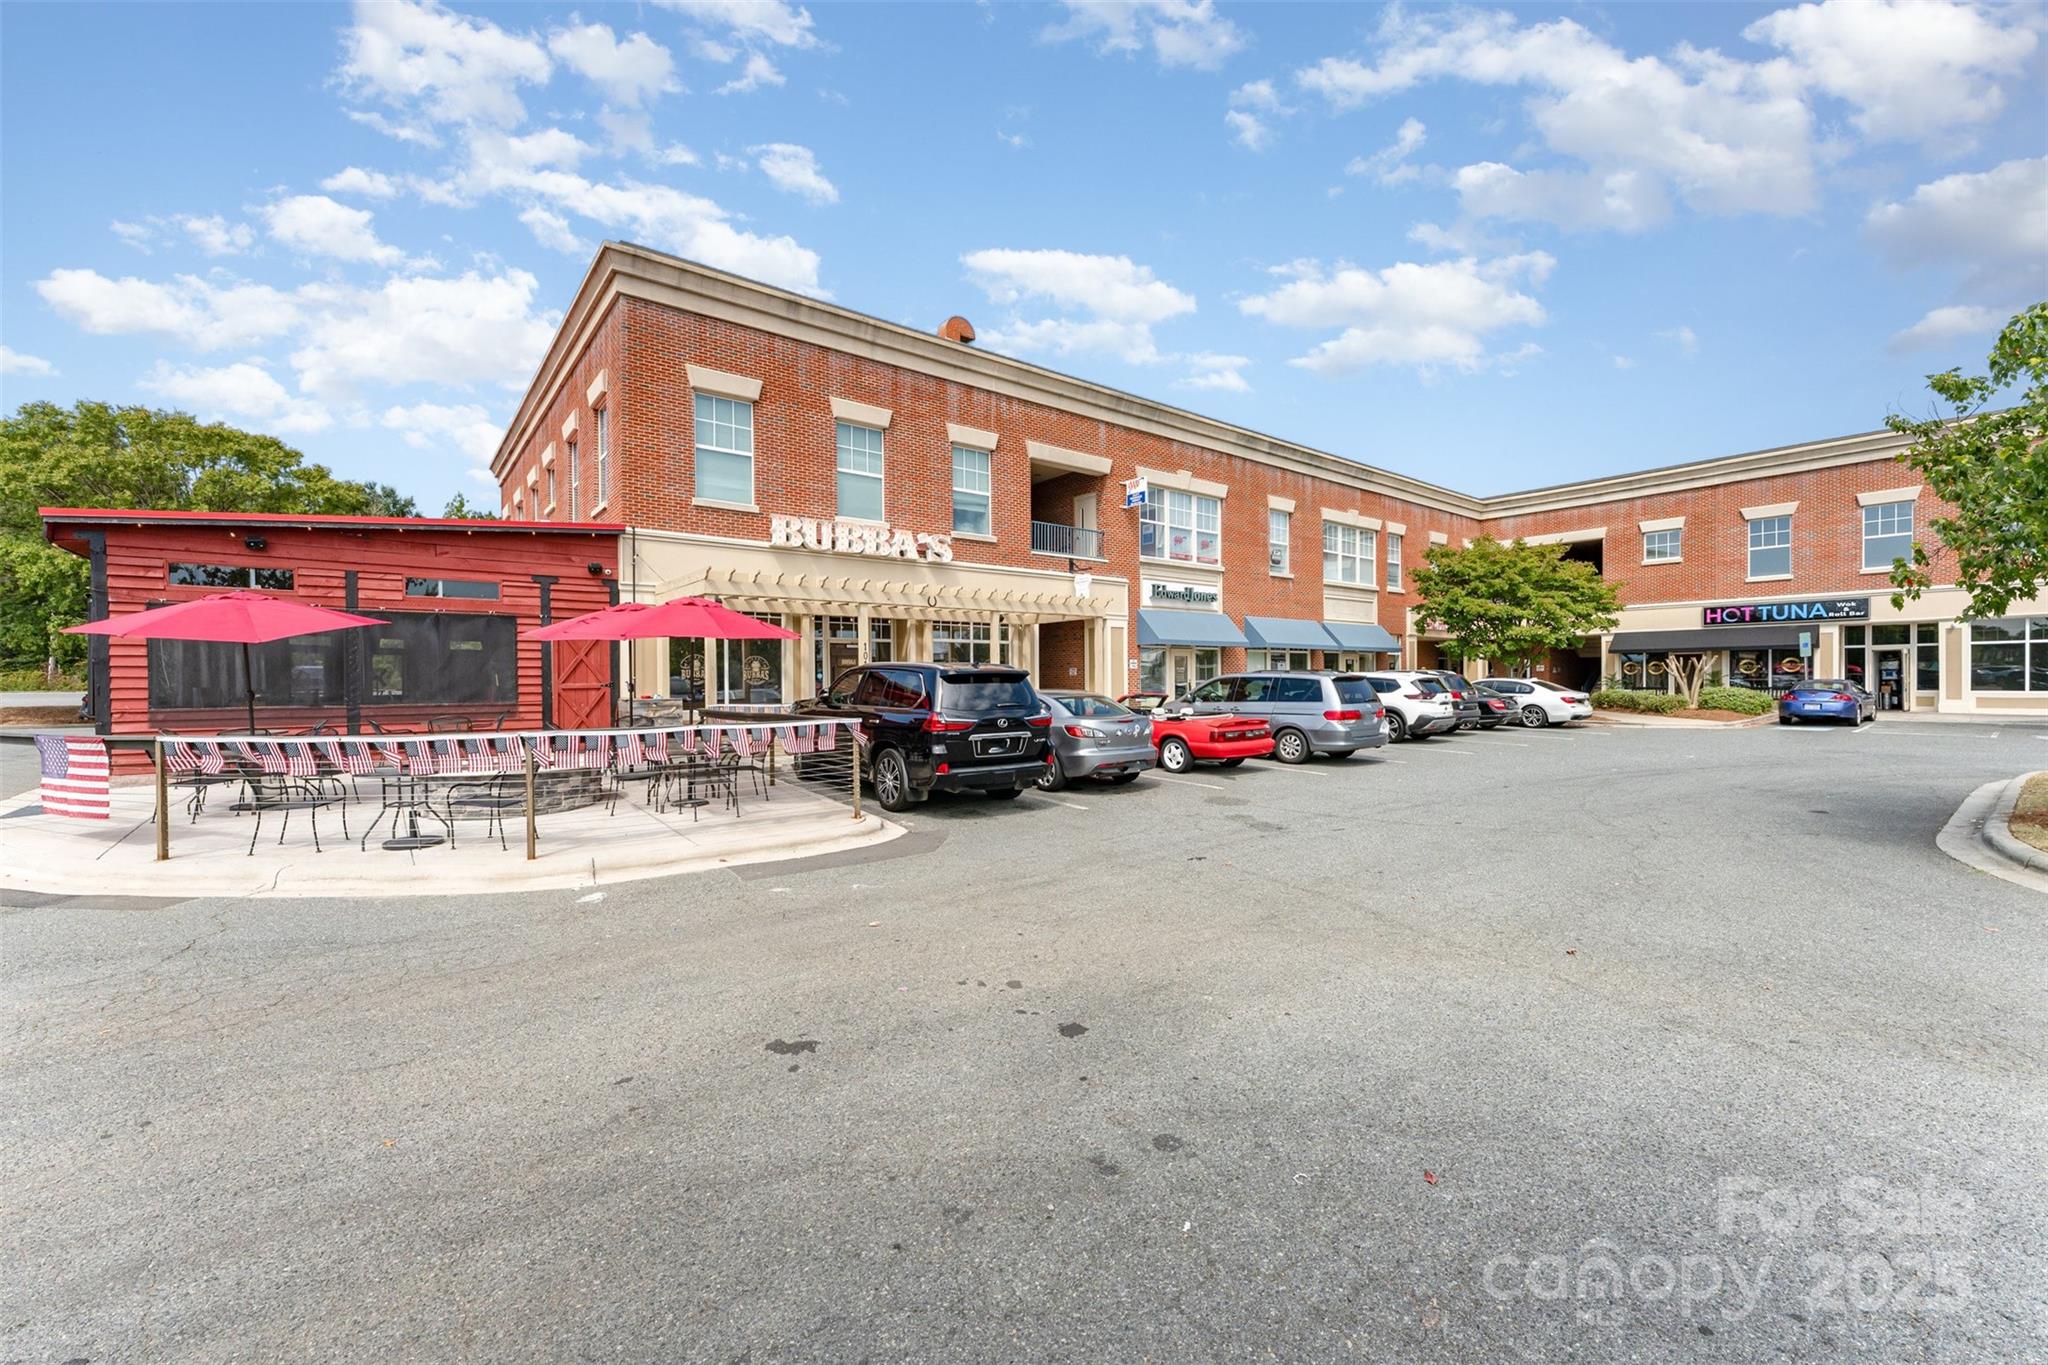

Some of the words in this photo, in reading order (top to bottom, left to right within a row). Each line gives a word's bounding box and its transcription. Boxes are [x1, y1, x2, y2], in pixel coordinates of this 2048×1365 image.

[770, 513, 954, 562] BUBBA'S
[1706, 606, 1754, 623] HOT
[1758, 603, 1828, 620] TUNA
